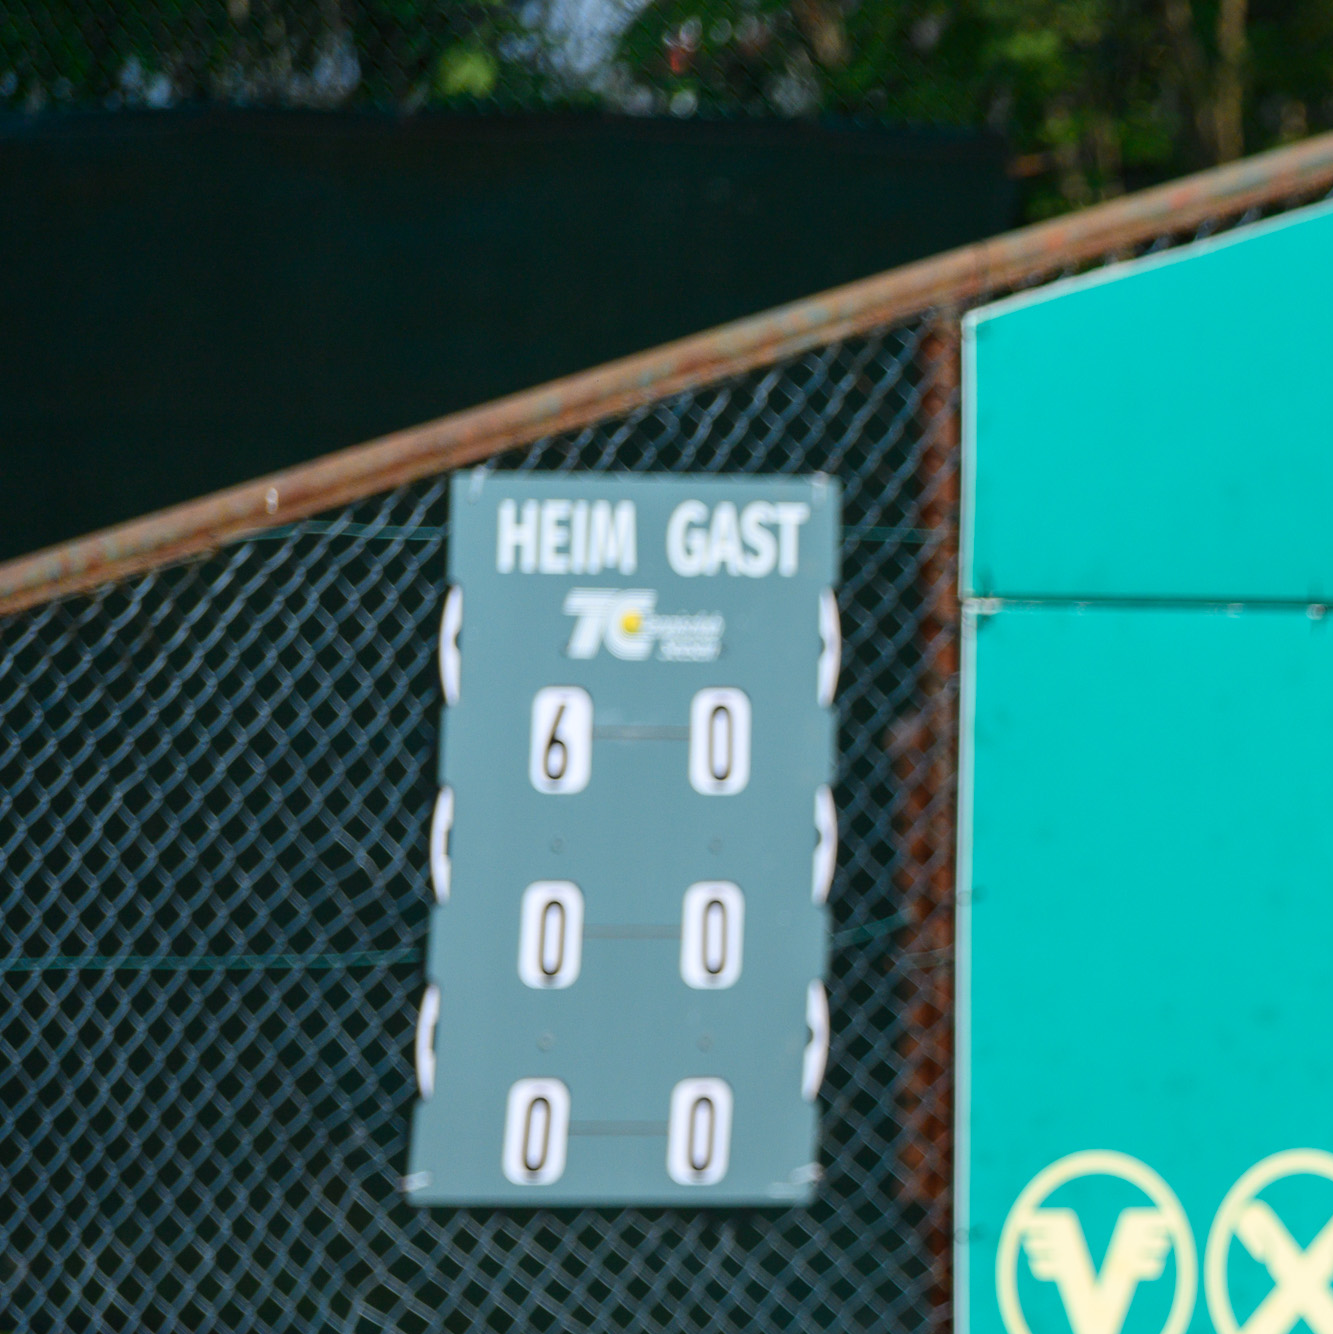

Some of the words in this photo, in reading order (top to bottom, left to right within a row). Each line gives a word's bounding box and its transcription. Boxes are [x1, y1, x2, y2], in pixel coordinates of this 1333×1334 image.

[497, 498, 637, 575] HEIM
[667, 500, 810, 577] GAST
[545, 703, 568, 780] 6
[709, 705, 733, 781] 0
[540, 899, 566, 976] 0
[703, 899, 727, 975] 0
[522, 1096, 551, 1172] 0
[691, 1096, 716, 1172] 0
